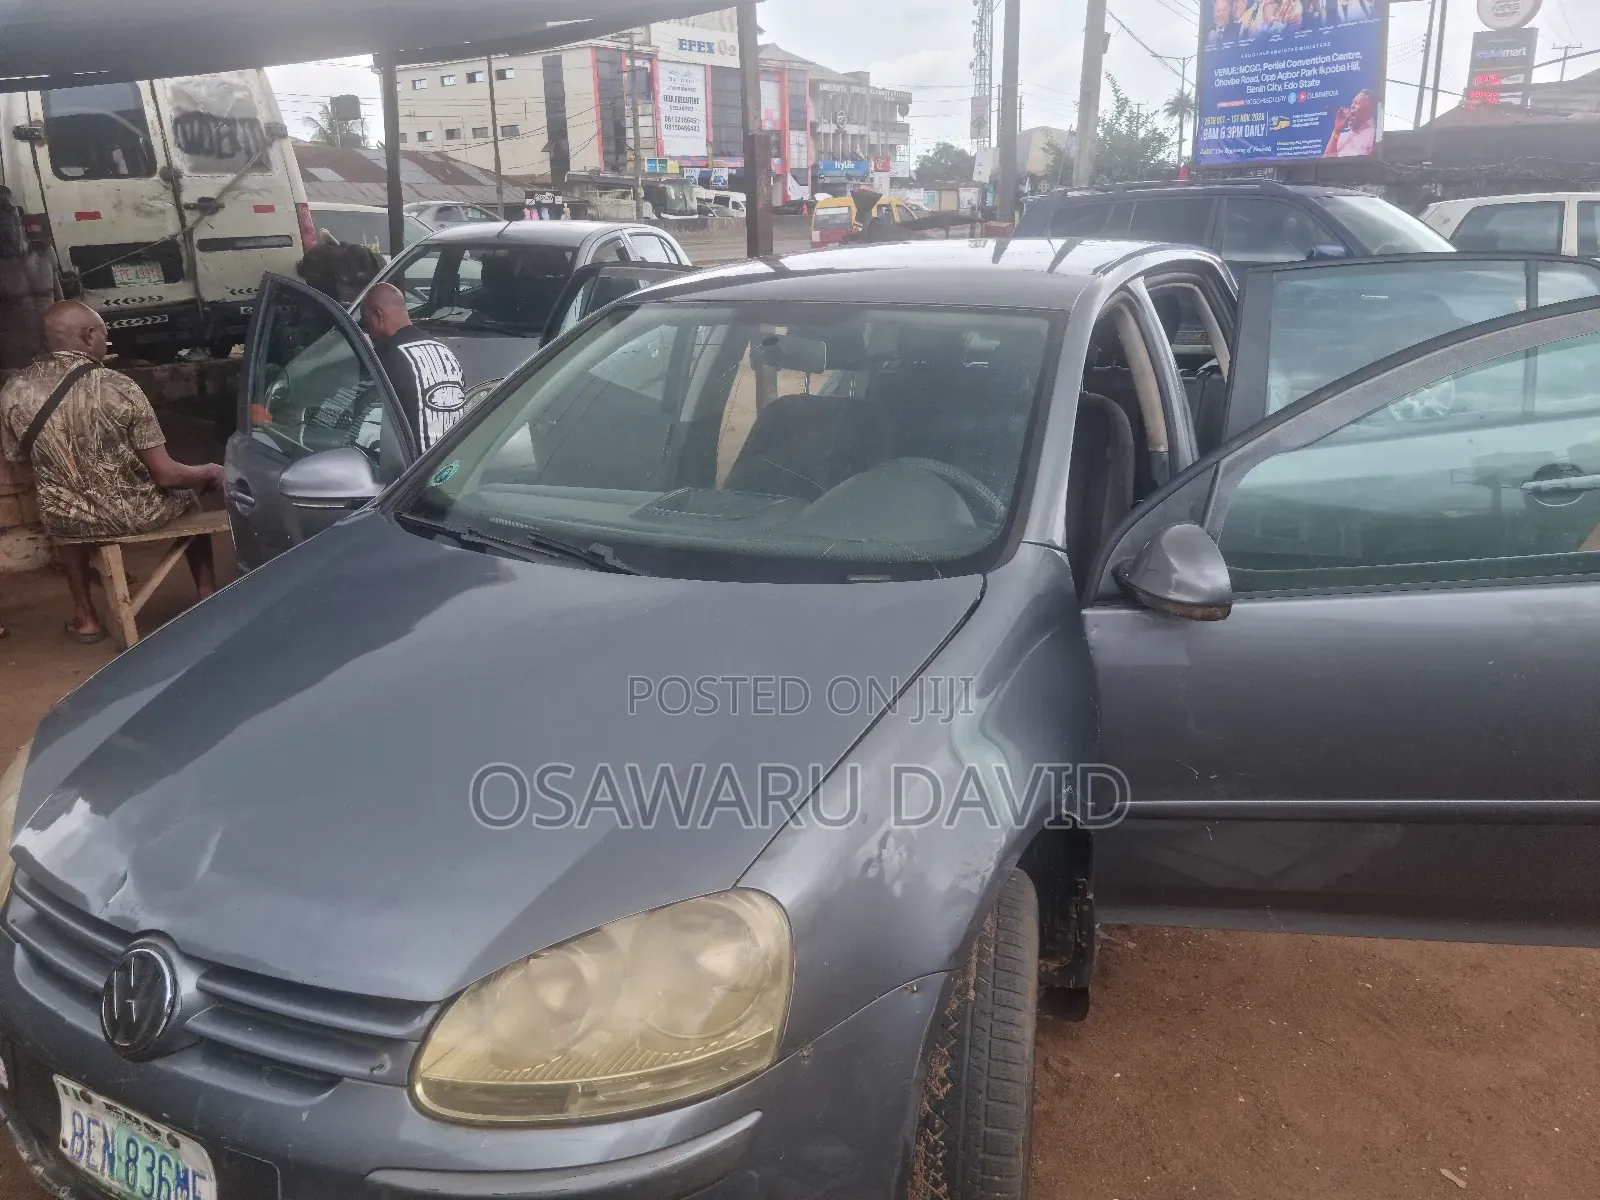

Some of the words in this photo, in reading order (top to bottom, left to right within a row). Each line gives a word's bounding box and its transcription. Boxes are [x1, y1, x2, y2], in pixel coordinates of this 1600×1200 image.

[678, 38, 715, 54] EFEX
[1214, 66, 1239, 77] VENUE:
[1287, 54, 1331, 68] Convention
[1332, 51, 1363, 61] Centre,
[1300, 67, 1318, 77] Park
[1246, 84, 1266, 94] Benin
[1267, 82, 1283, 93] City,
[1284, 81, 1298, 91] Edo
[1299, 78, 1321, 89] State
[1203, 127, 1218, 141] 9AM
[1226, 125, 1243, 139] 3PM
[1244, 123, 1266, 138] DAILY
